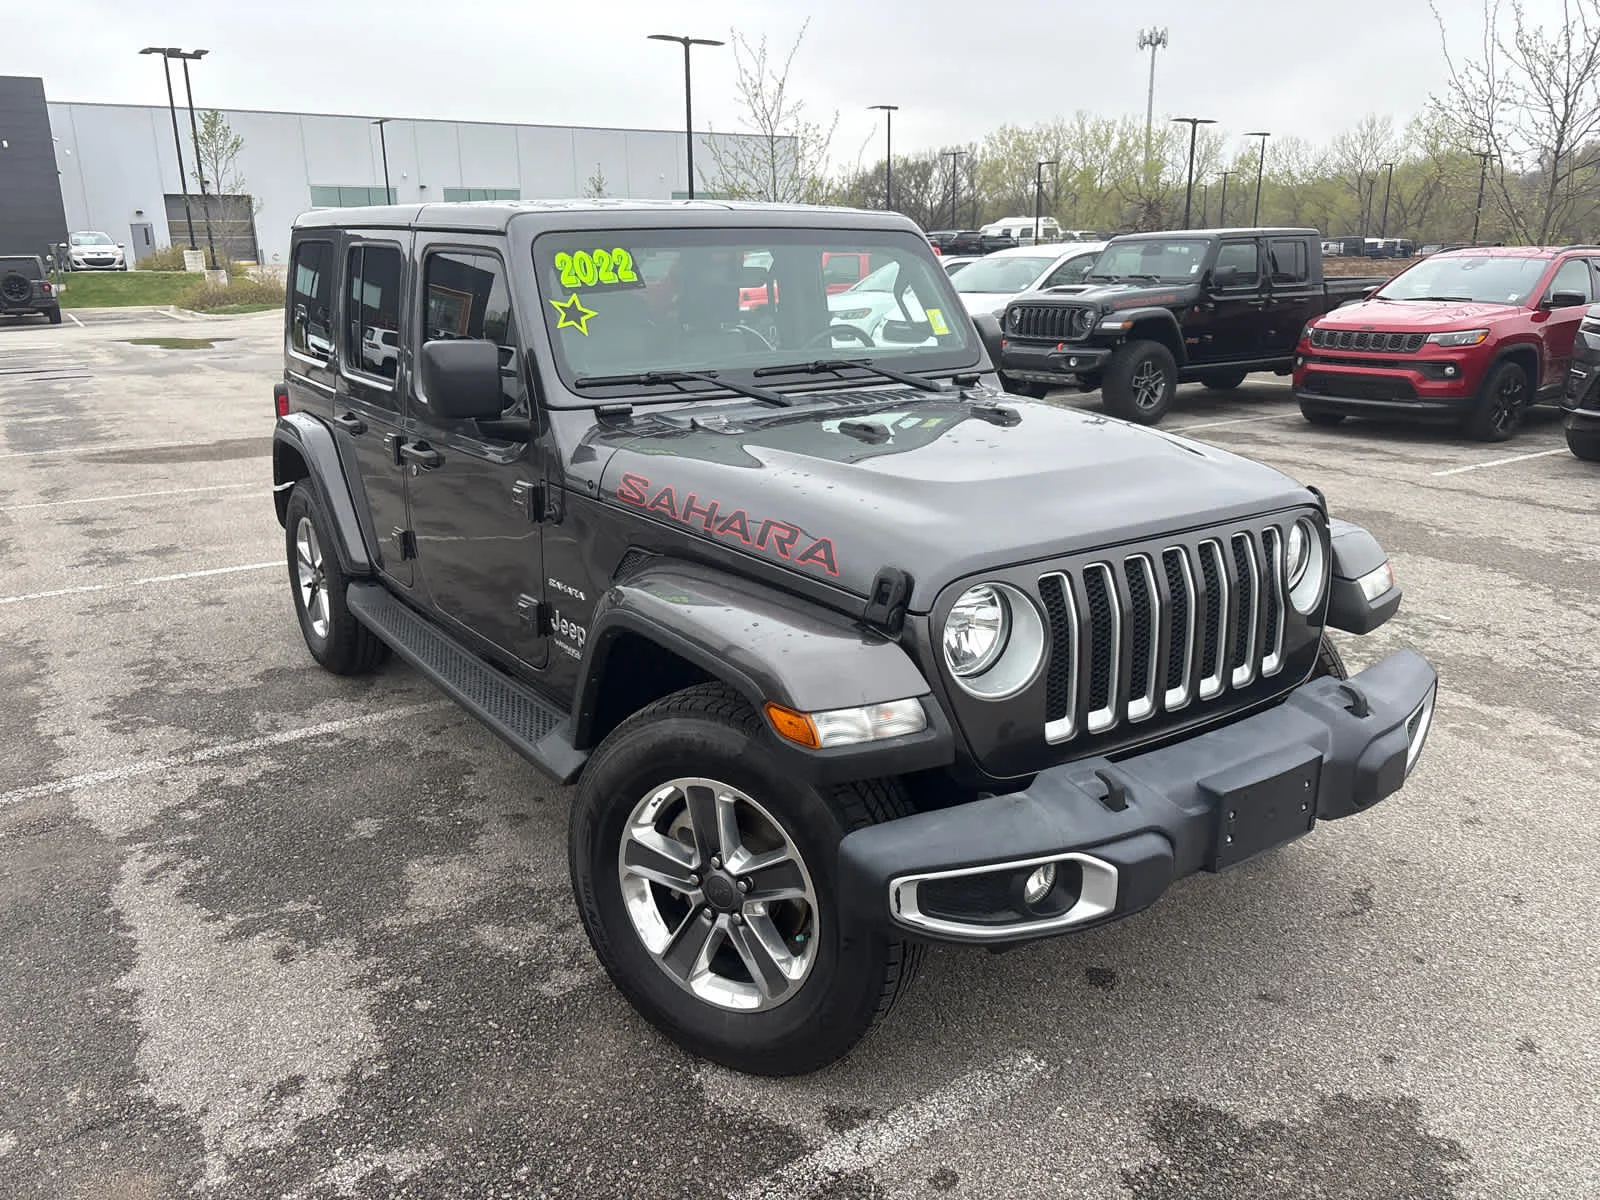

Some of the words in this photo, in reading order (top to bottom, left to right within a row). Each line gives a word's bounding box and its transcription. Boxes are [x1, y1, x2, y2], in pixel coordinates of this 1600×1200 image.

[555, 247, 638, 288] 2022
[617, 472, 840, 577] SAHARA
[551, 609, 586, 648] Jeep
